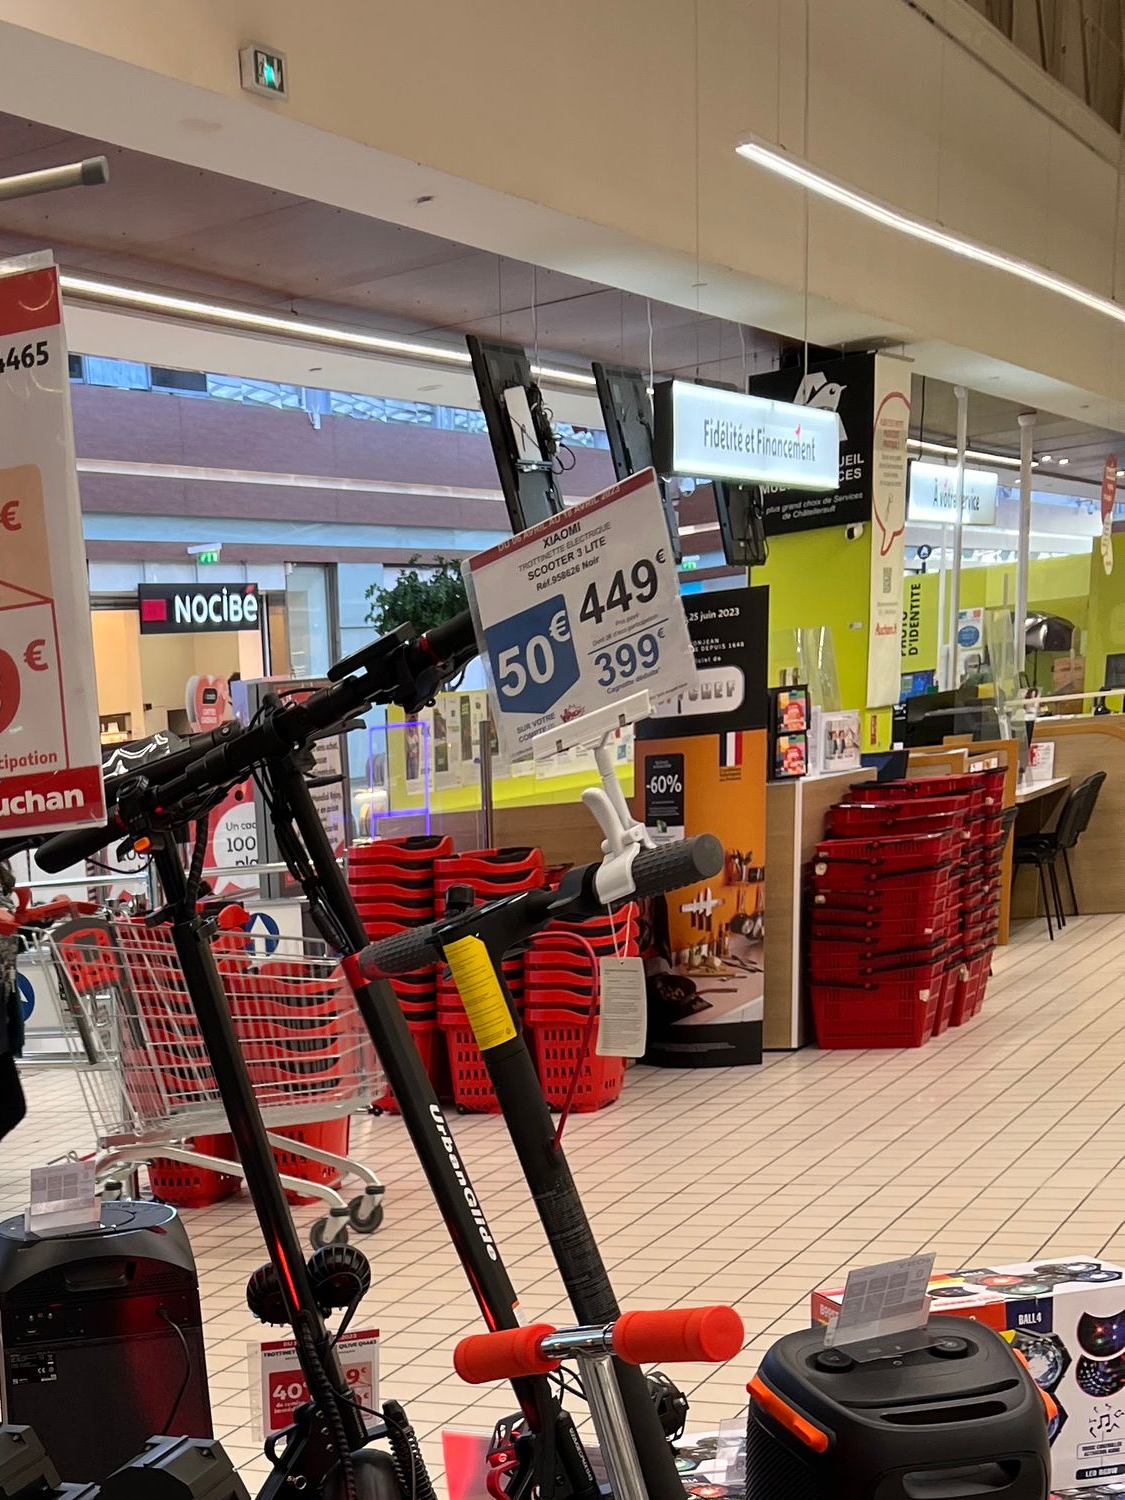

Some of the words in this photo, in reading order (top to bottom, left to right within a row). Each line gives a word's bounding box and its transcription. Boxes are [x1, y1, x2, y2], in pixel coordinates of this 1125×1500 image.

[703, 420, 743, 454] Fidélité
[745, 434, 755, 454] et
[757, 428, 816, 462] Financement
[542, 522, 581, 549] XIAOMI
[527, 552, 575, 581] SCOOTER
[577, 547, 583, 559] 3
[585, 536, 607, 554] LITE
[700, 609, 716, 622] juin
[718, 607, 741, 618] 2023
[517, 720, 531, 735] SUR
[532, 712, 555, 729] VOTRE
[646, 774, 682, 795] -60%
[1017, 1311, 1043, 1326] BALL4
